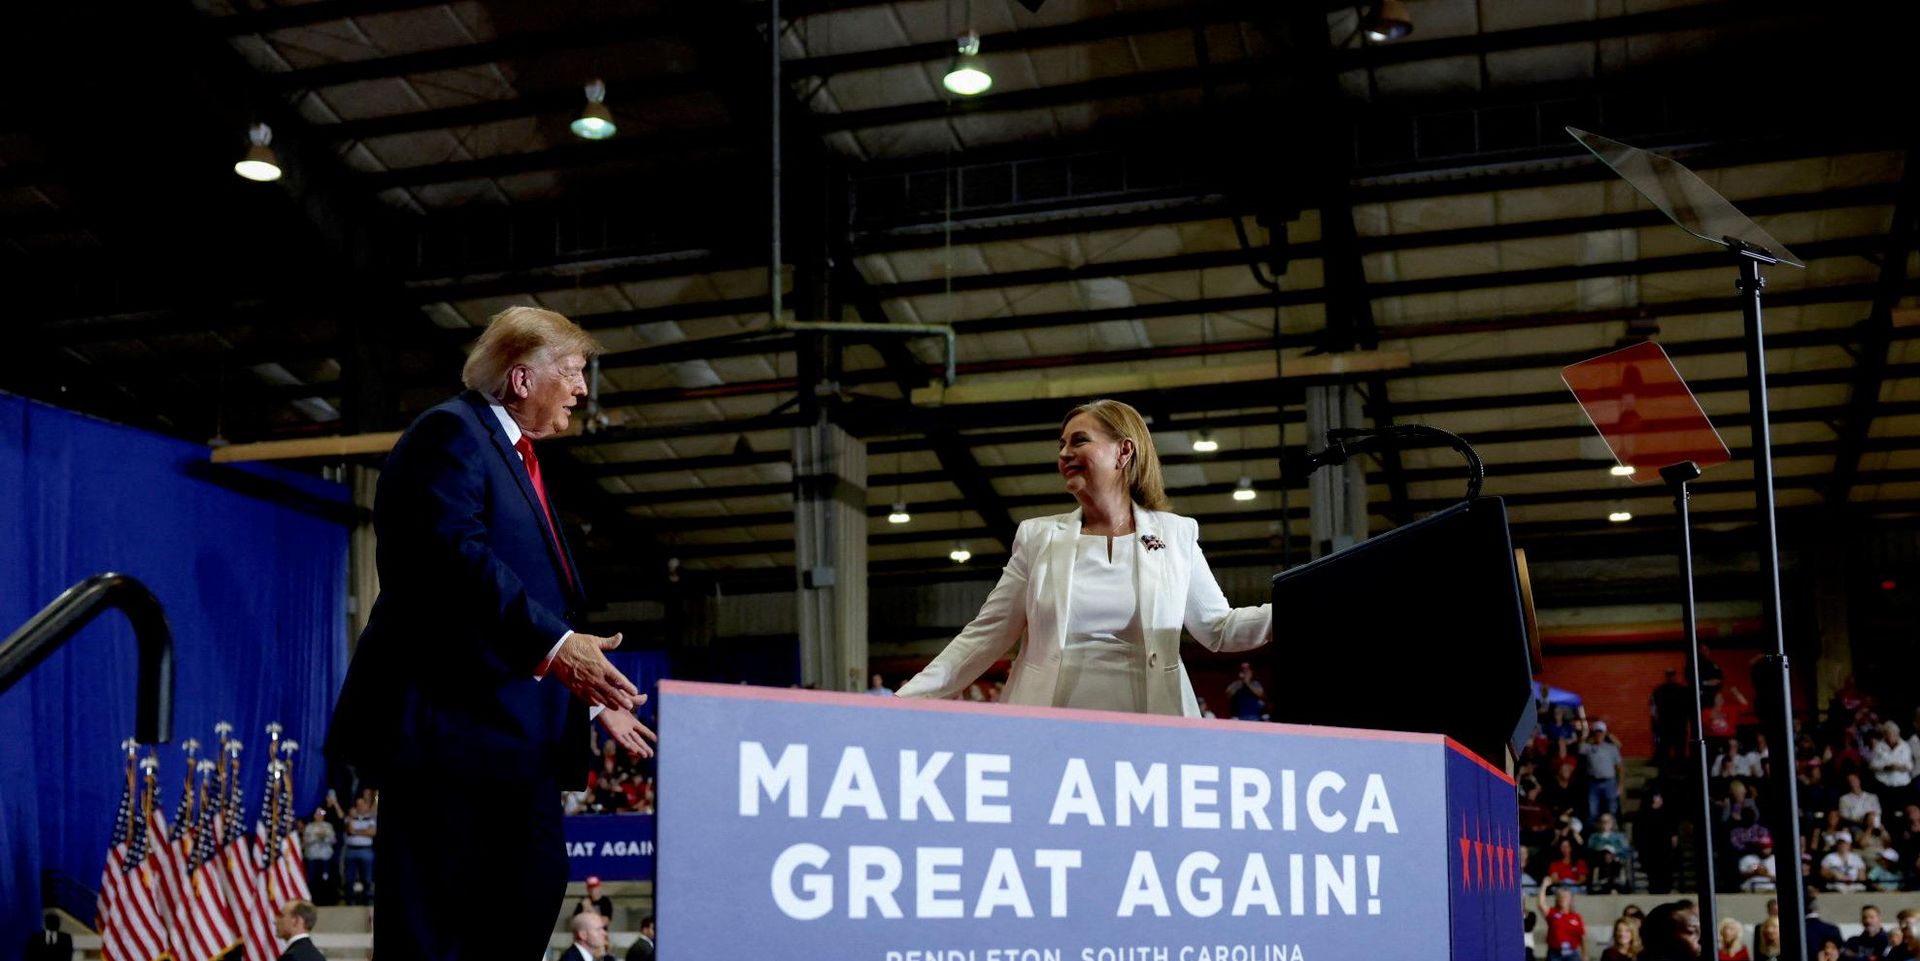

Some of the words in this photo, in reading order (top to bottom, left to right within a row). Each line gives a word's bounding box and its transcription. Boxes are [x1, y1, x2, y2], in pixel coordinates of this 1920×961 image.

[738, 741, 1012, 823] MAKE
[1048, 758, 1400, 834] AMERICA
[770, 843, 1083, 920] GREAT
[1116, 850, 1382, 918] AGAIN!
